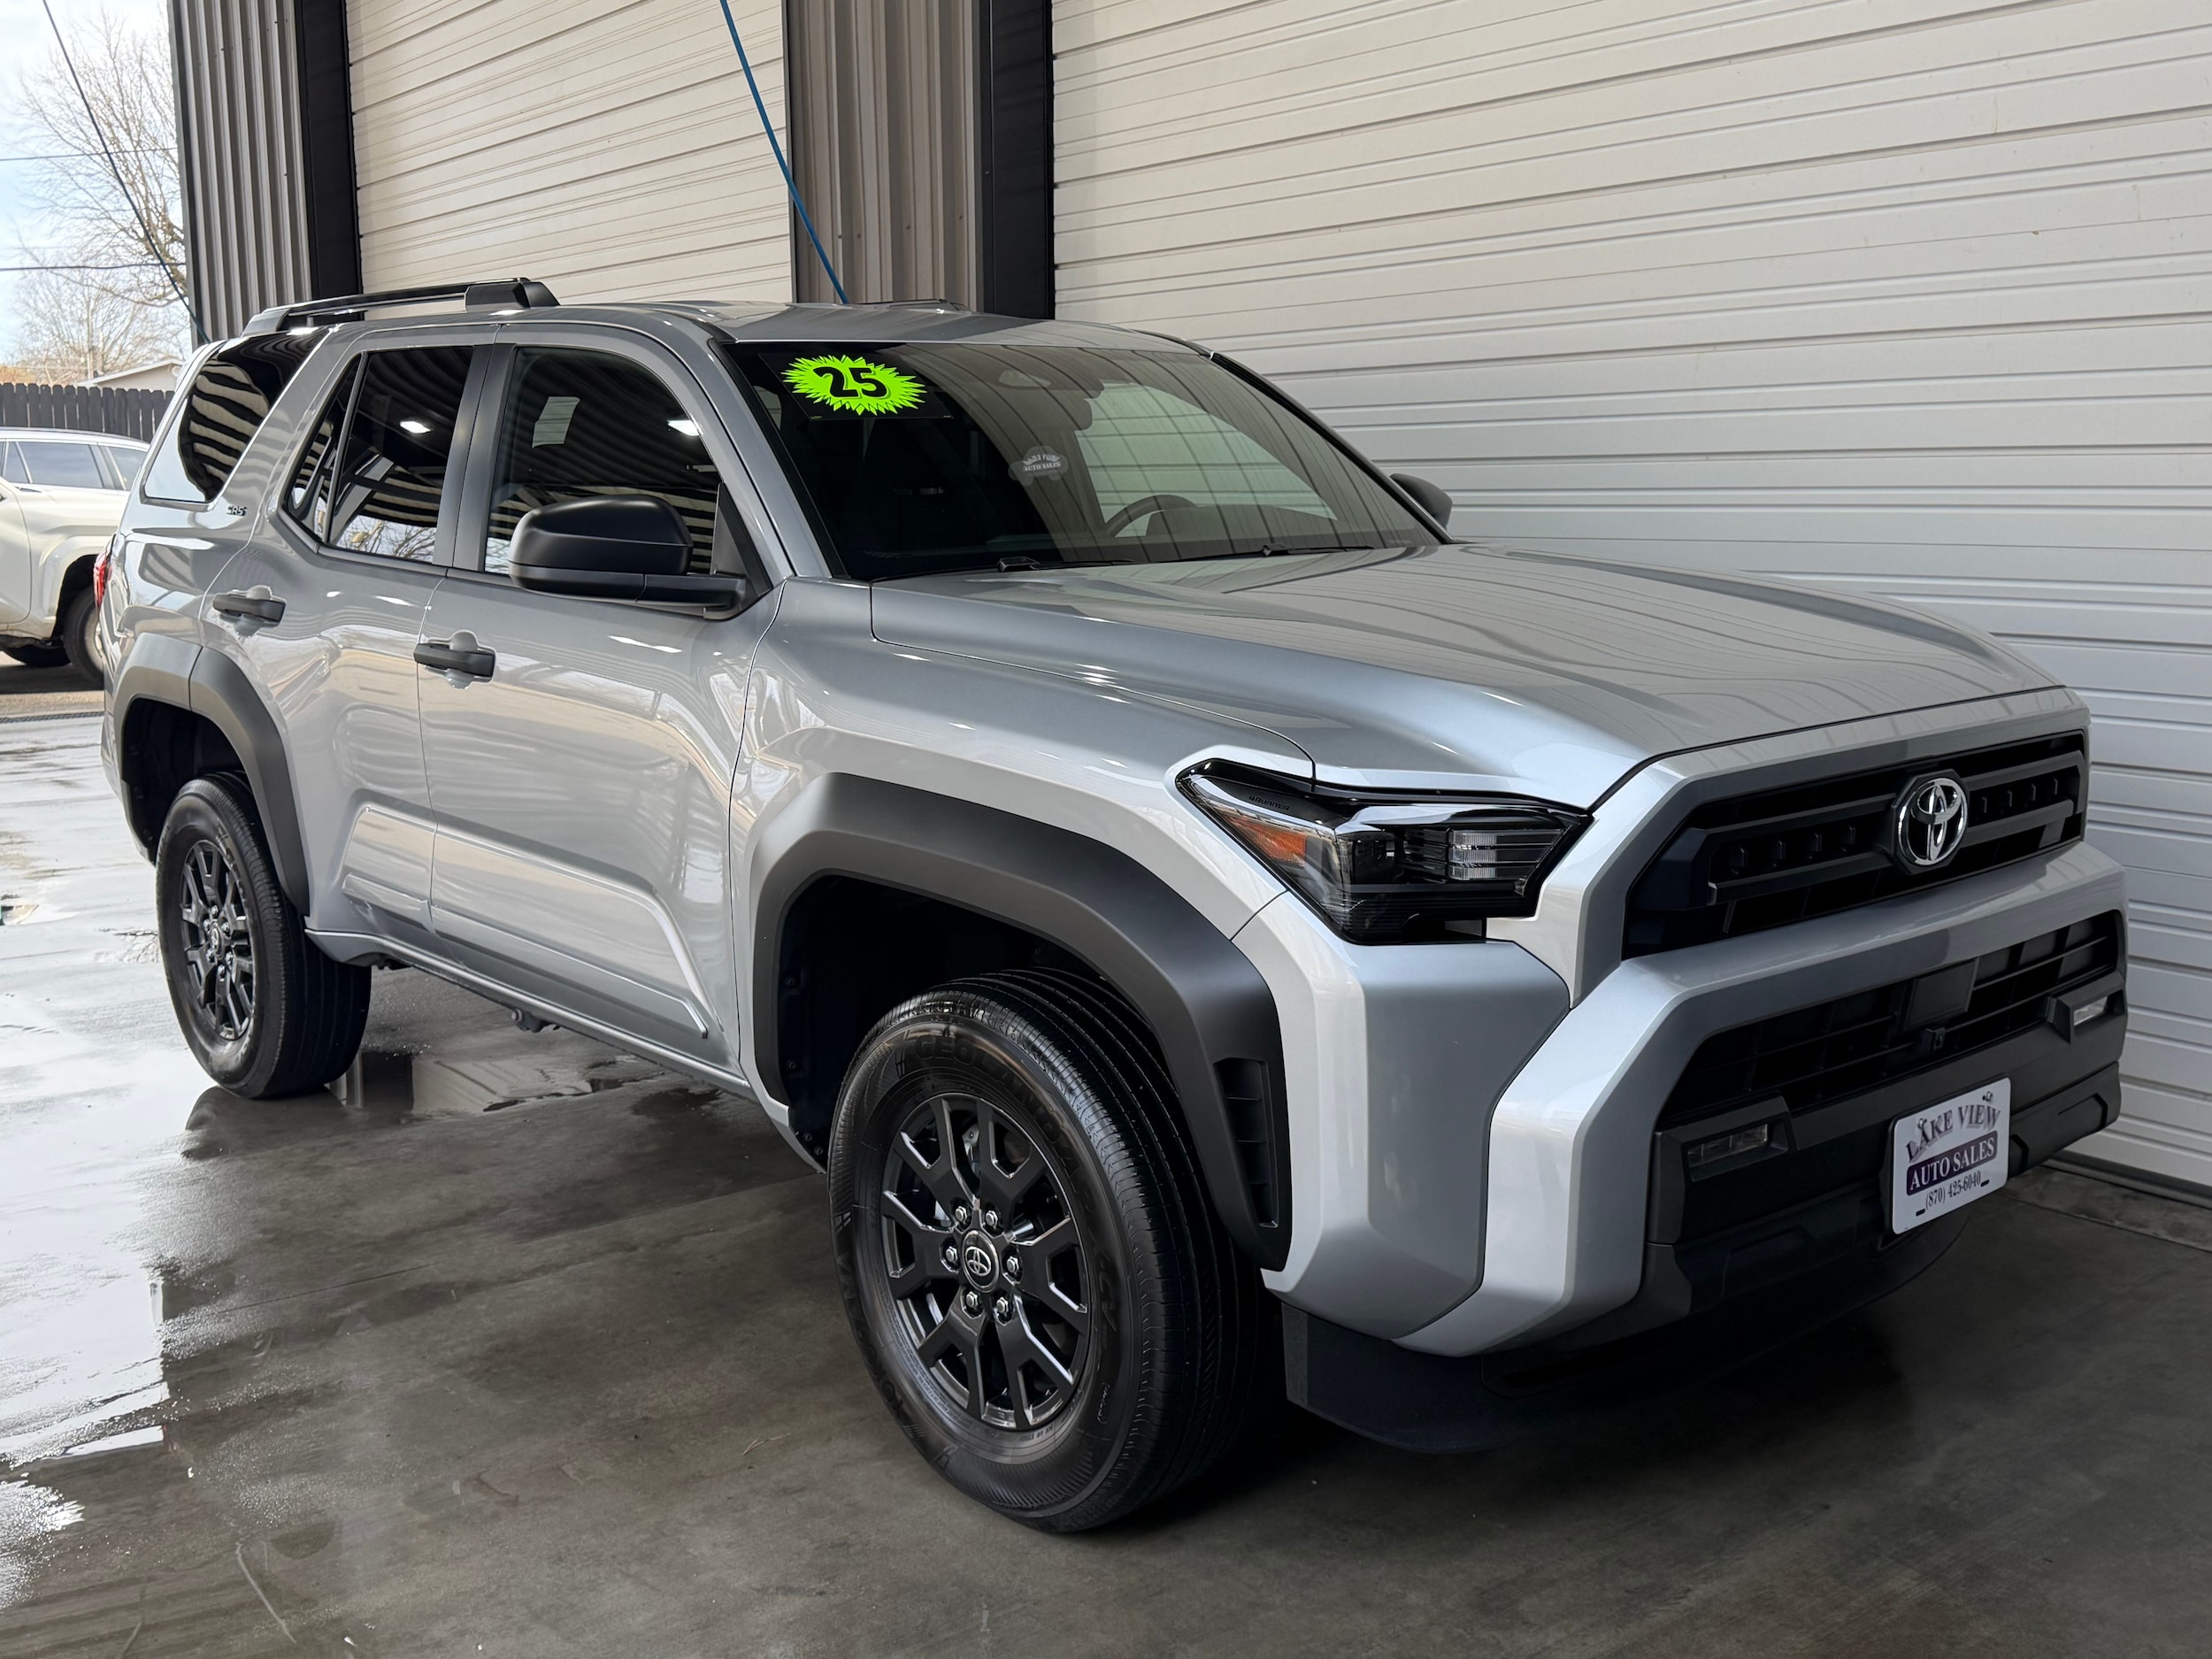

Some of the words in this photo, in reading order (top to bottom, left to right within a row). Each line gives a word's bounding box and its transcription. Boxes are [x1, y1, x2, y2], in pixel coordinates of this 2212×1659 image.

[812, 366, 890, 400] 25
[1906, 1110, 1954, 1164] LAKE
[1958, 1104, 2001, 1131] VIEW
[1909, 1157, 1951, 1191] AUTO
[1953, 1137, 1995, 1172] SALES
[1925, 1185, 1946, 1210] (870)
[1947, 1171, 1981, 1198] 425-6040
